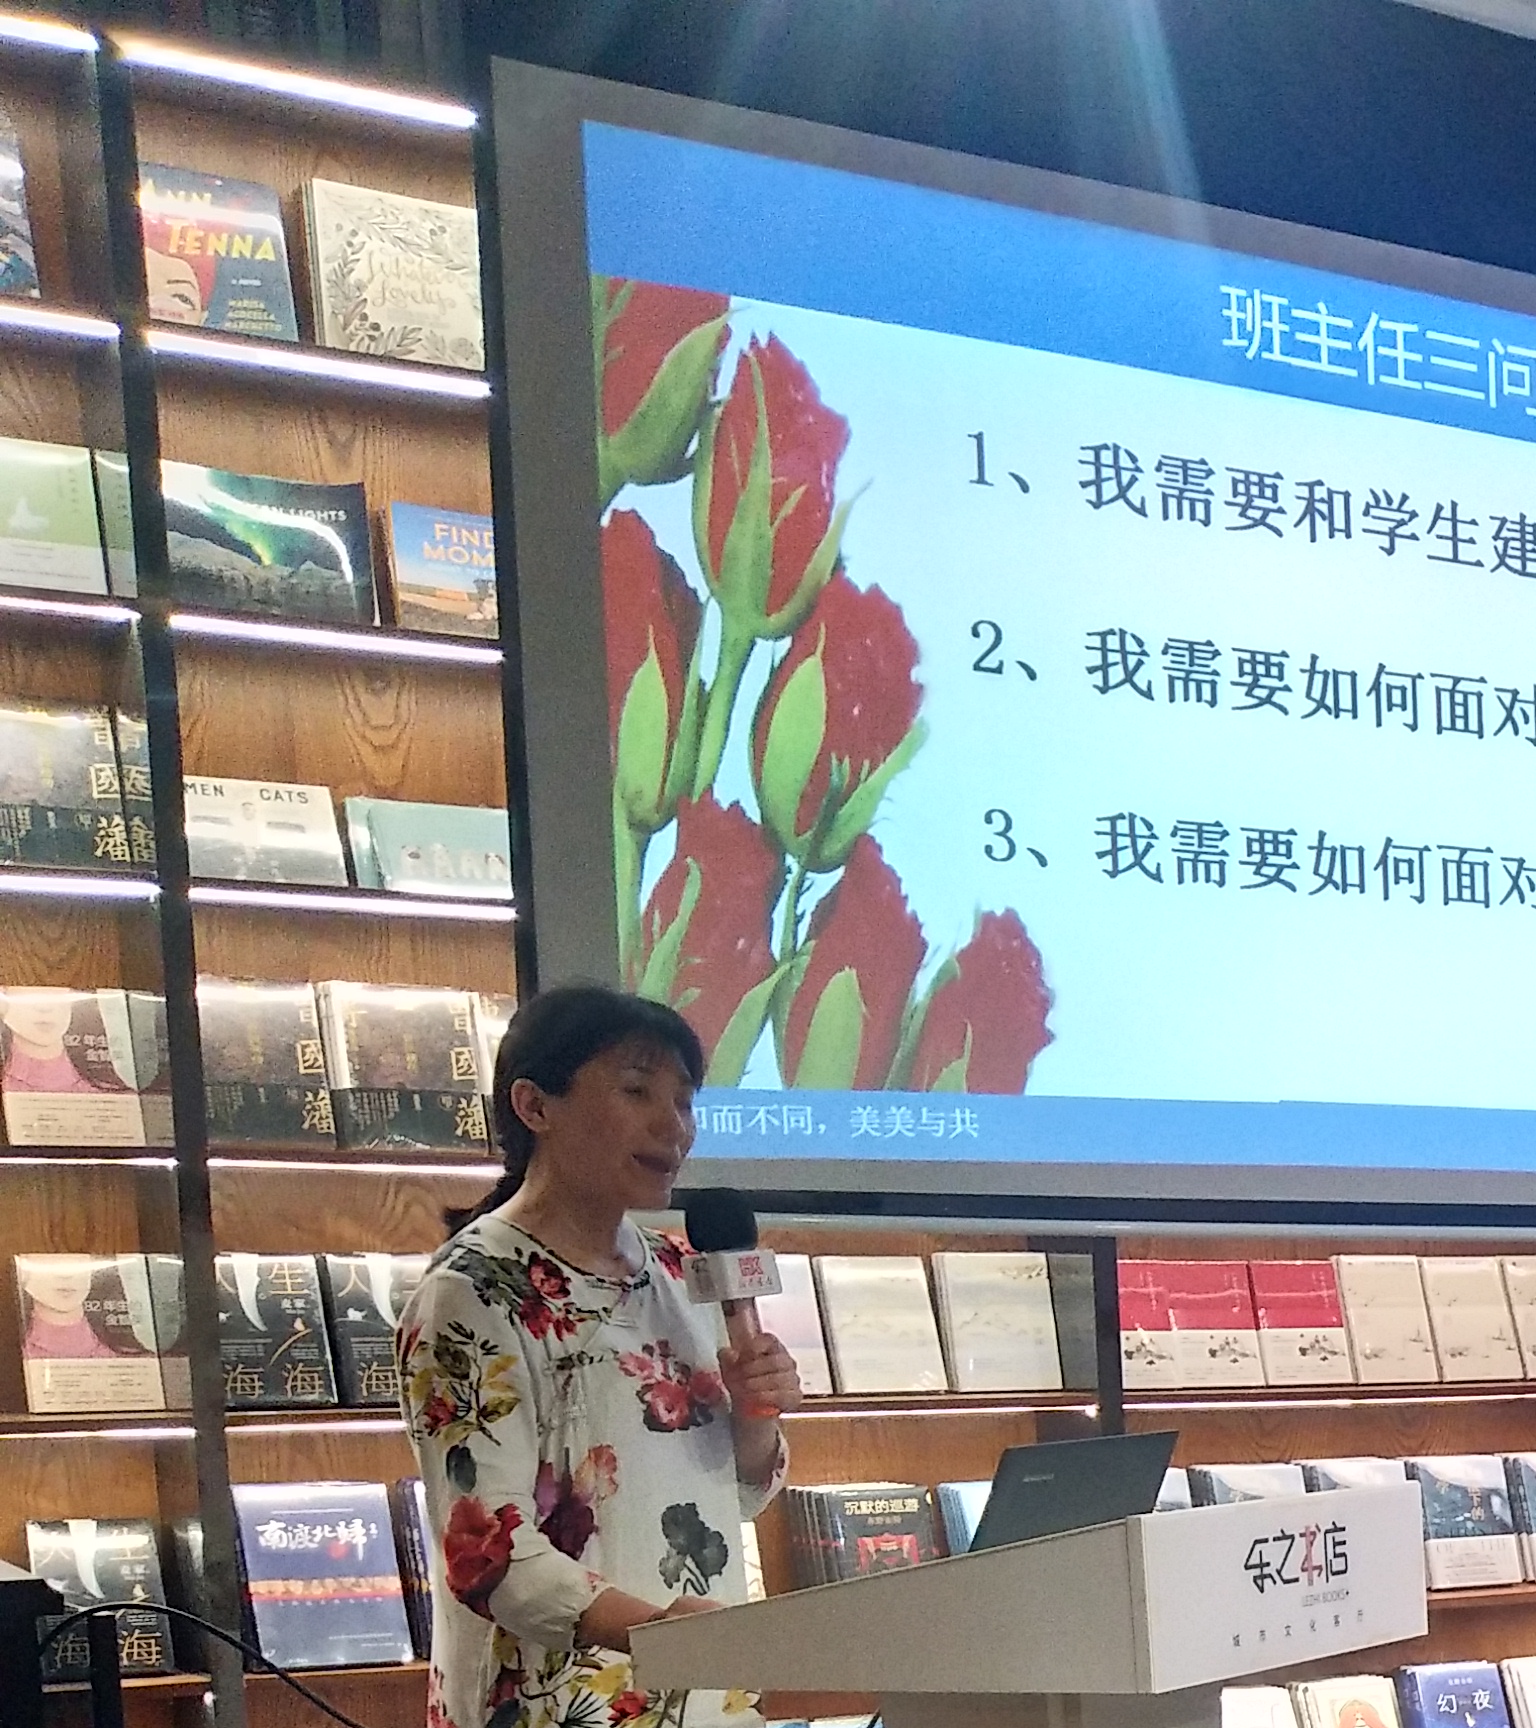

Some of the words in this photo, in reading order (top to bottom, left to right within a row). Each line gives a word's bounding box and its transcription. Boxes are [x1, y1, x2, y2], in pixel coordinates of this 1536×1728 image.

[165, 218, 277, 262] TENNA
[258, 788, 310, 805] CATS
[84, 1300, 101, 1313] 82
[359, 1361, 399, 1397] 海
[843, 1497, 920, 1516] 沉默的巡游
[1243, 1521, 1349, 1594] 乐之书店
[119, 1628, 164, 1668] 海
[1436, 1689, 1494, 1714] 幻夜
